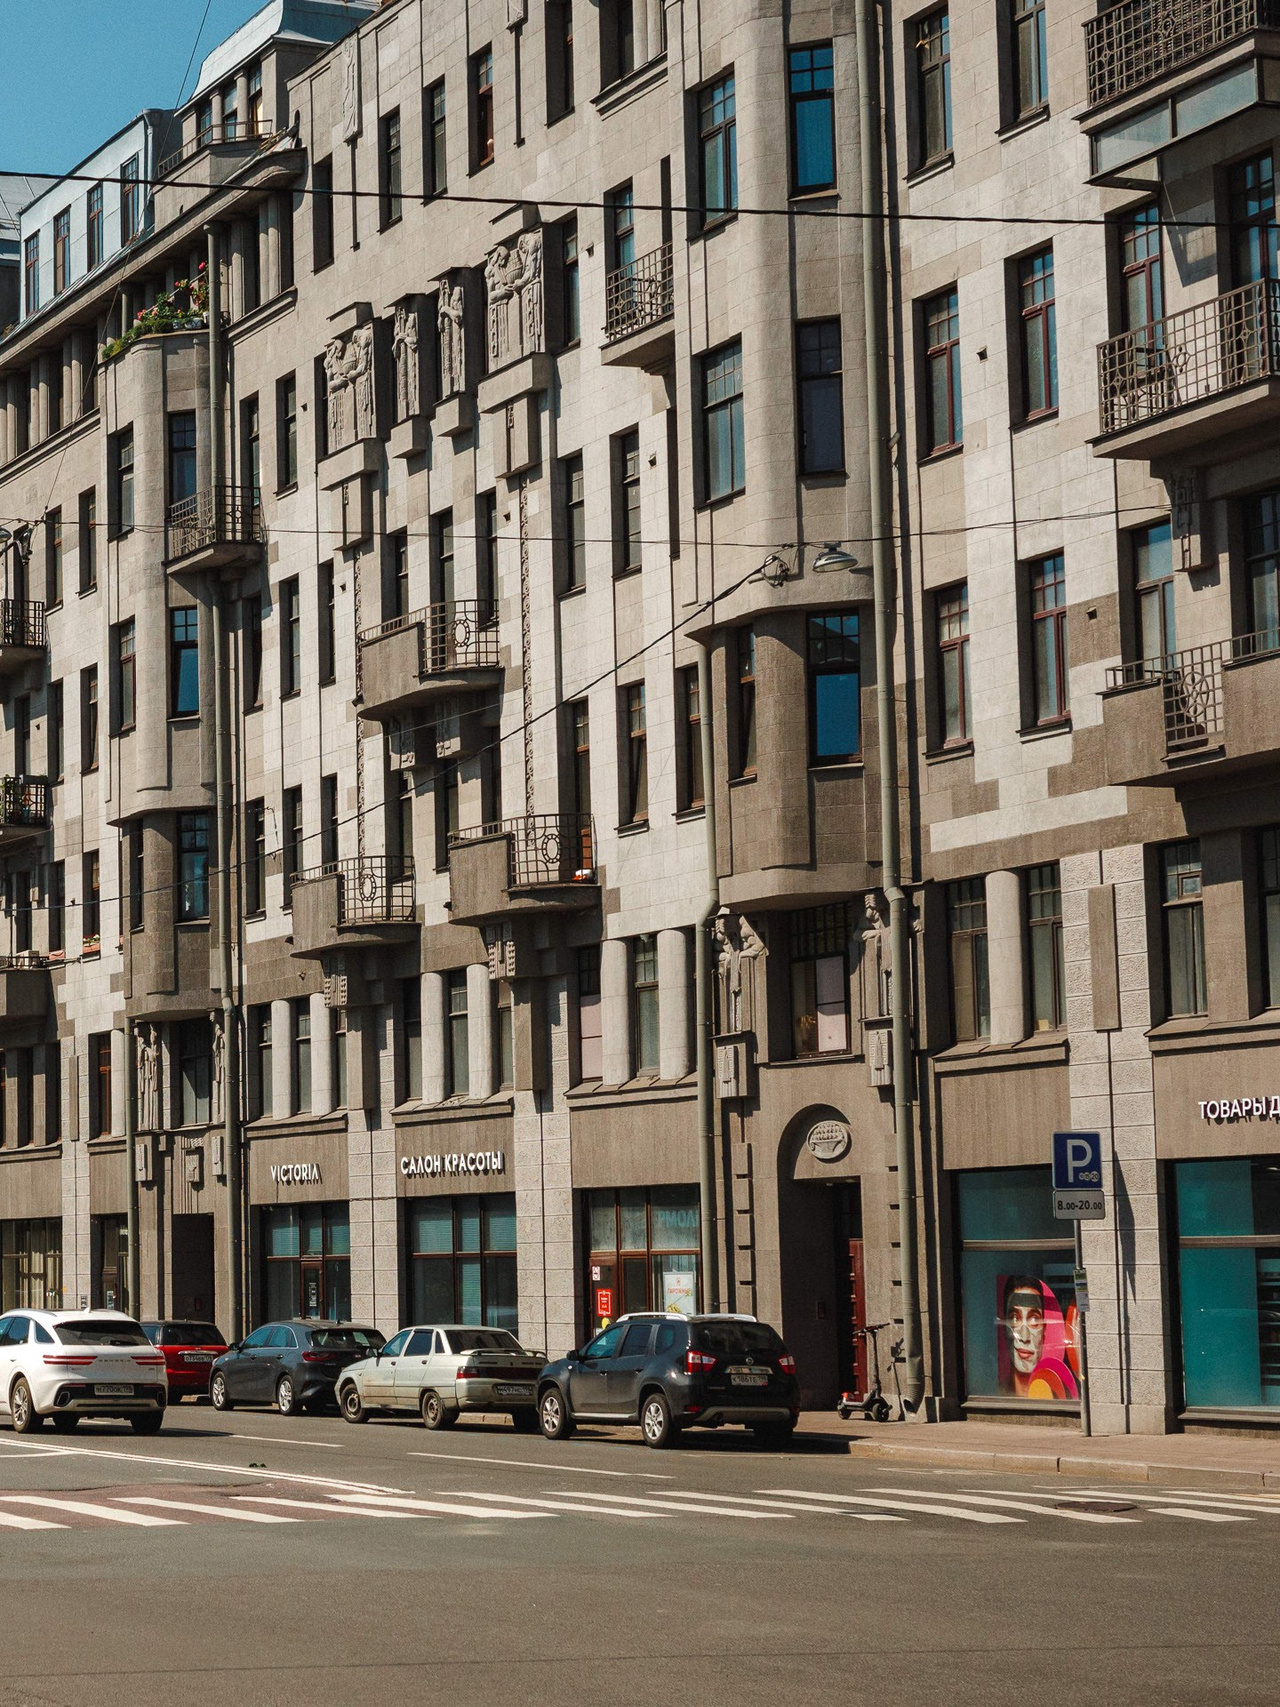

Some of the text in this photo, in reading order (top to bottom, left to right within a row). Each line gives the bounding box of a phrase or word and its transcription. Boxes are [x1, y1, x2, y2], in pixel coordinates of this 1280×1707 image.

[1198, 1096, 1267, 1119] ТОВАРЫ
[270, 1163, 320, 1182] VICTORIA
[401, 1150, 502, 1174] САЛОН КРАСОТЫ
[1067, 1139, 1093, 1183] P
[1057, 1200, 1103, 1210] 8.00-20.00
